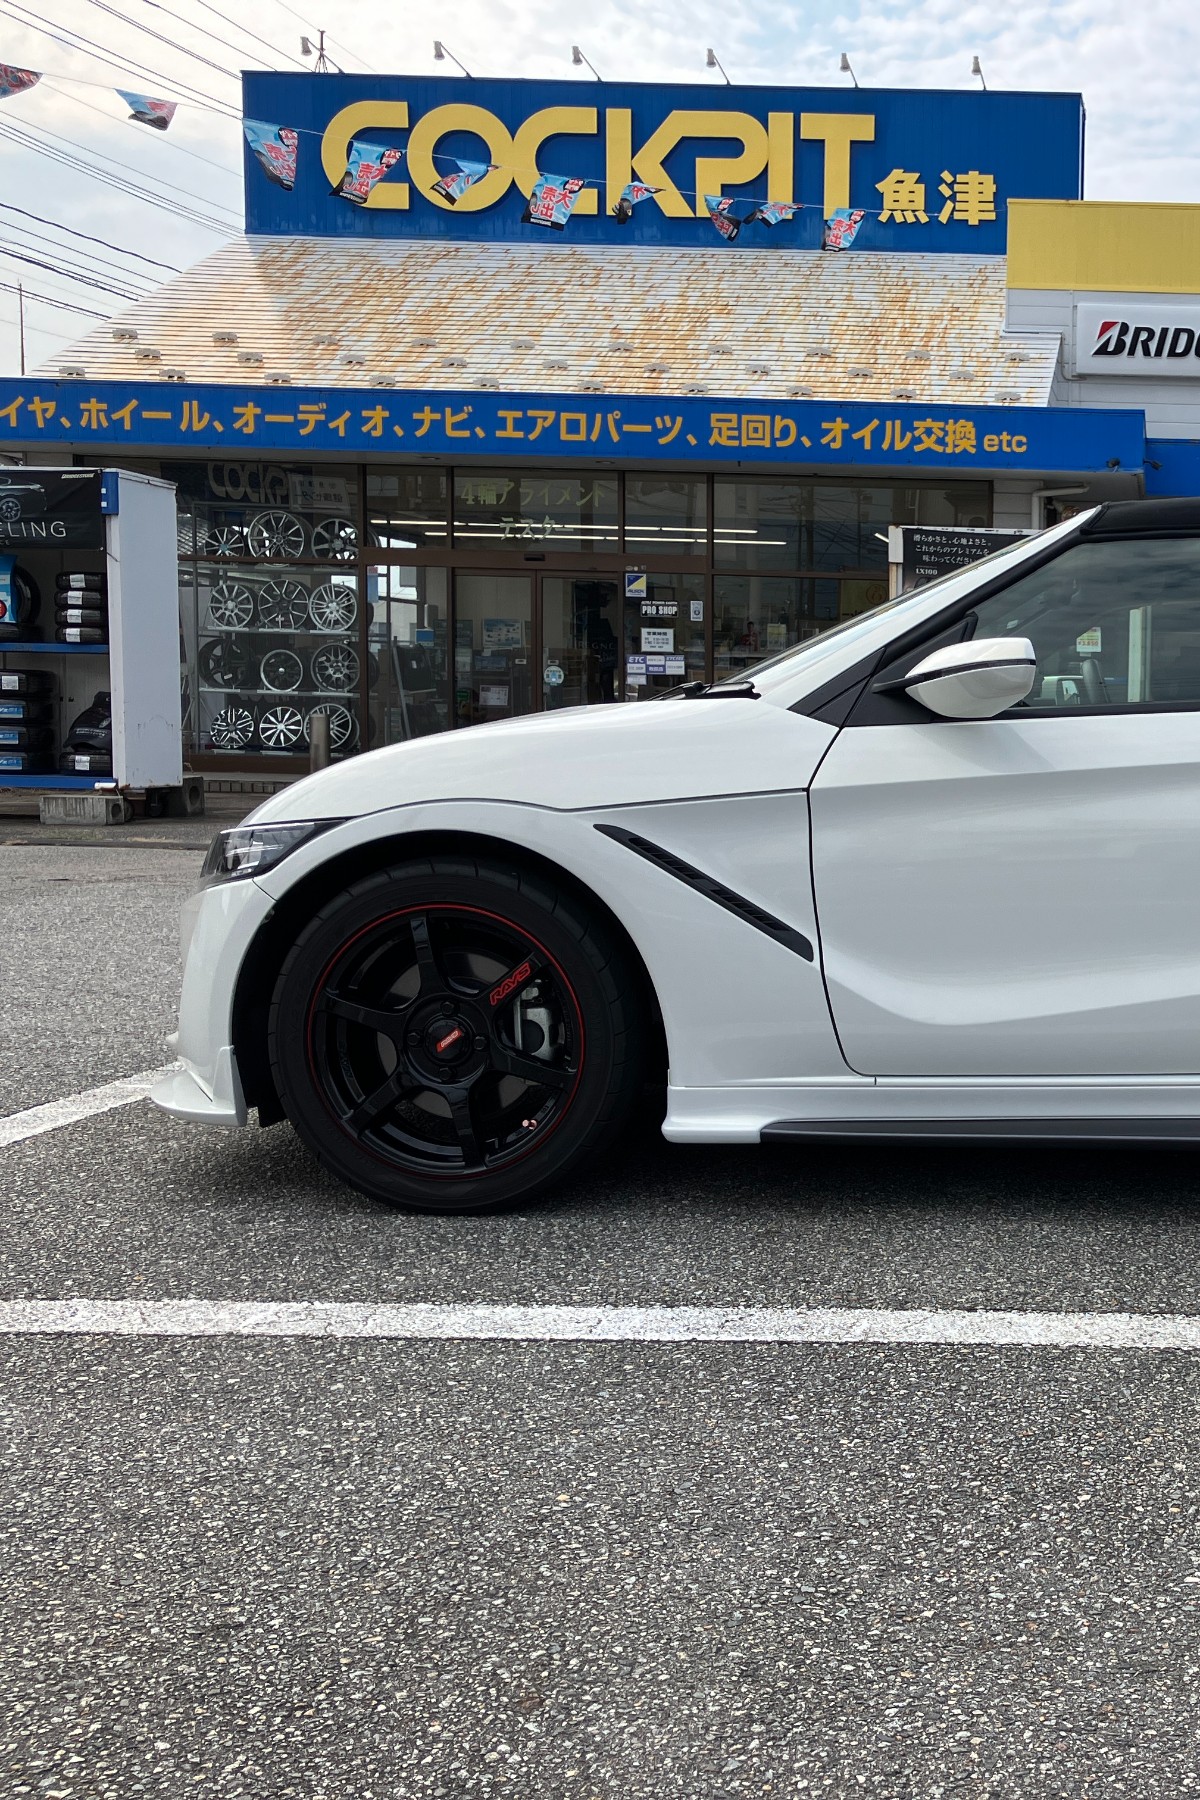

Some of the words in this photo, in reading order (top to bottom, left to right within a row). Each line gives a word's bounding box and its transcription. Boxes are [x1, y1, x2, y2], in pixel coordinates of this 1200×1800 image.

[320, 100, 876, 221] COCKPIT
[874, 168, 998, 225] 魚津
[983, 431, 1027, 453] etc
[461, 481, 606, 508] 4輪アライメント
[499, 515, 575, 541] テスター
[642, 605, 657, 615] PRO
[658, 605, 678, 615] SHOP
[489, 961, 532, 1006] RAYS
